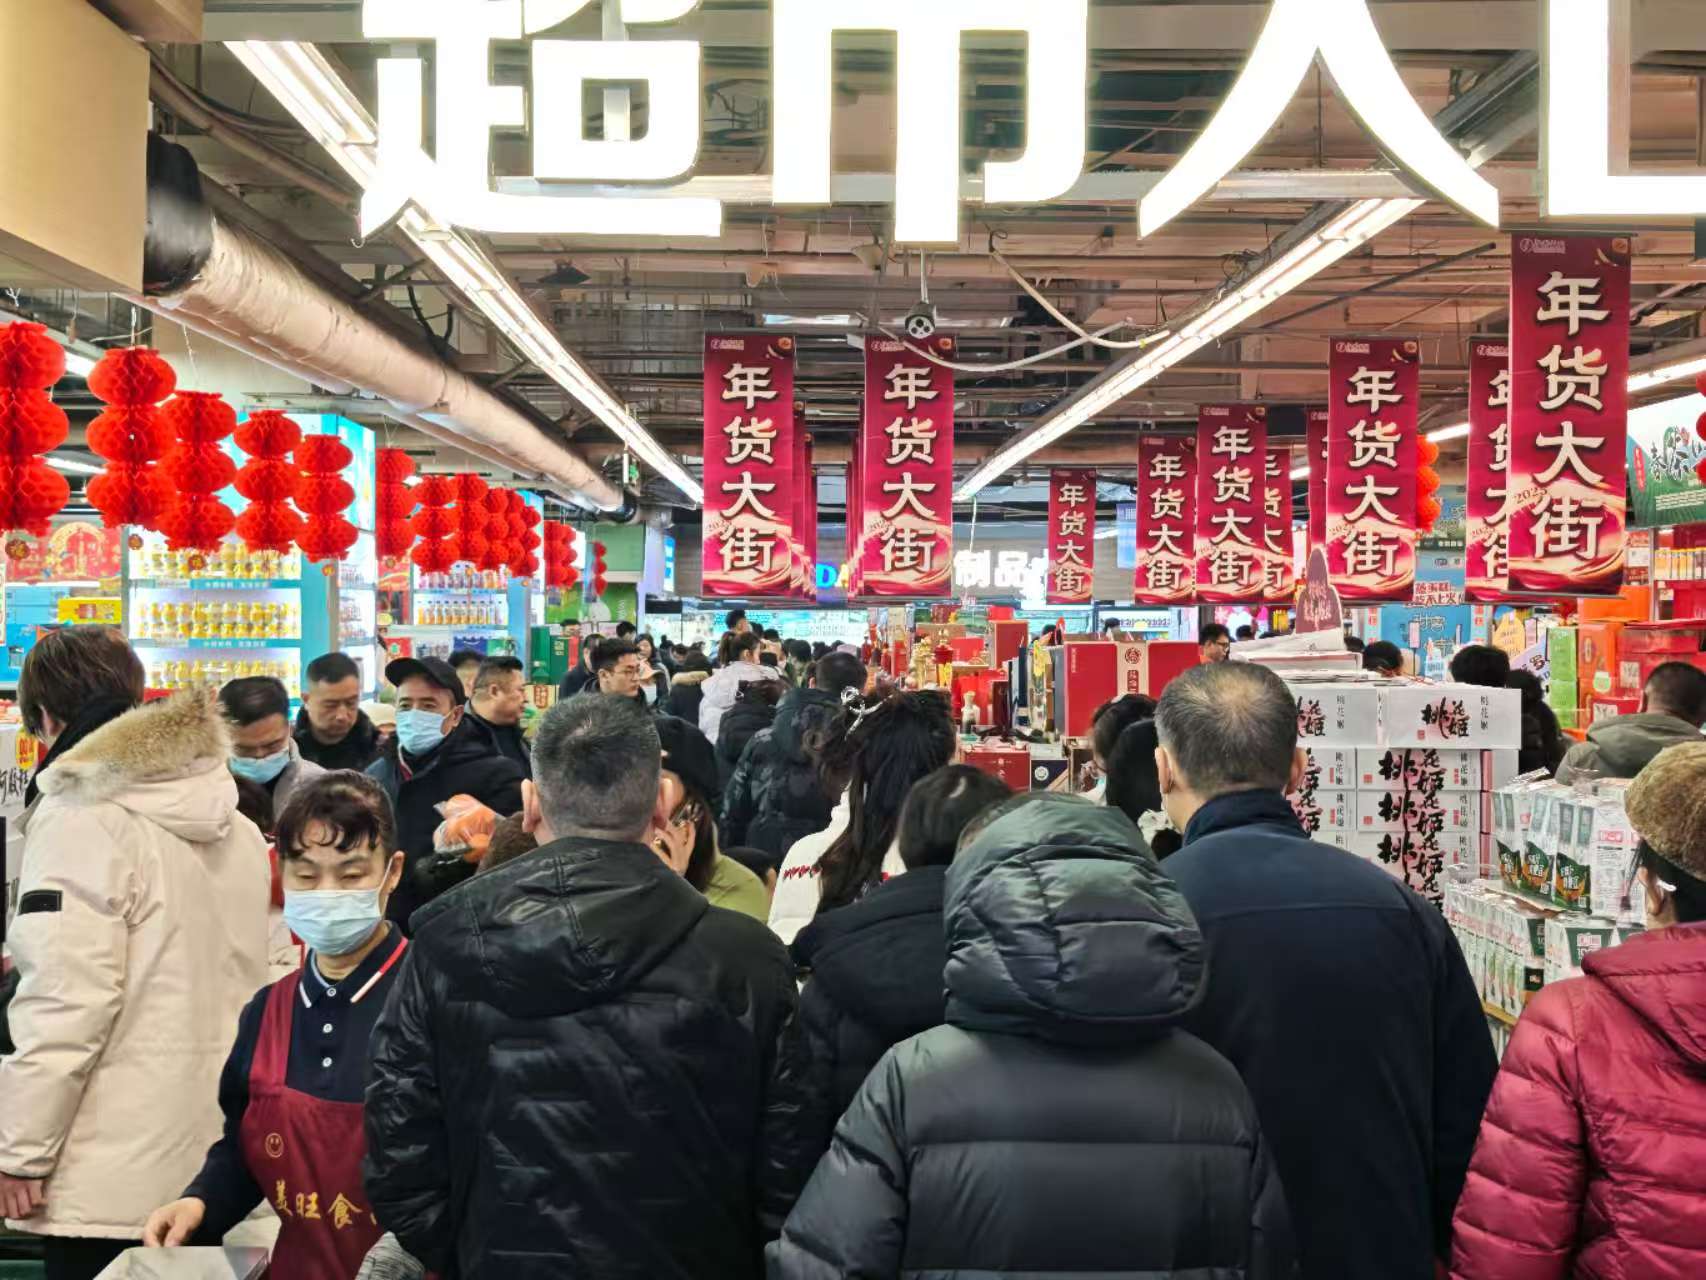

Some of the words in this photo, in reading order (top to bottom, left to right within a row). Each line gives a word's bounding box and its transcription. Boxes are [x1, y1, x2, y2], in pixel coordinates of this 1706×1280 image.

[719, 362, 777, 573] 年货大街
[880, 362, 939, 573] 年货大街
[1344, 366, 1403, 576] 年货大街
[1532, 271, 1609, 559] 年货大街
[1055, 483, 1089, 594] 年货大街
[1146, 452, 1187, 590] 年货大街
[1211, 425, 1255, 586] 年货大街
[1421, 696, 1471, 739] 桃花姬
[274, 1179, 378, 1230] 美旺食
